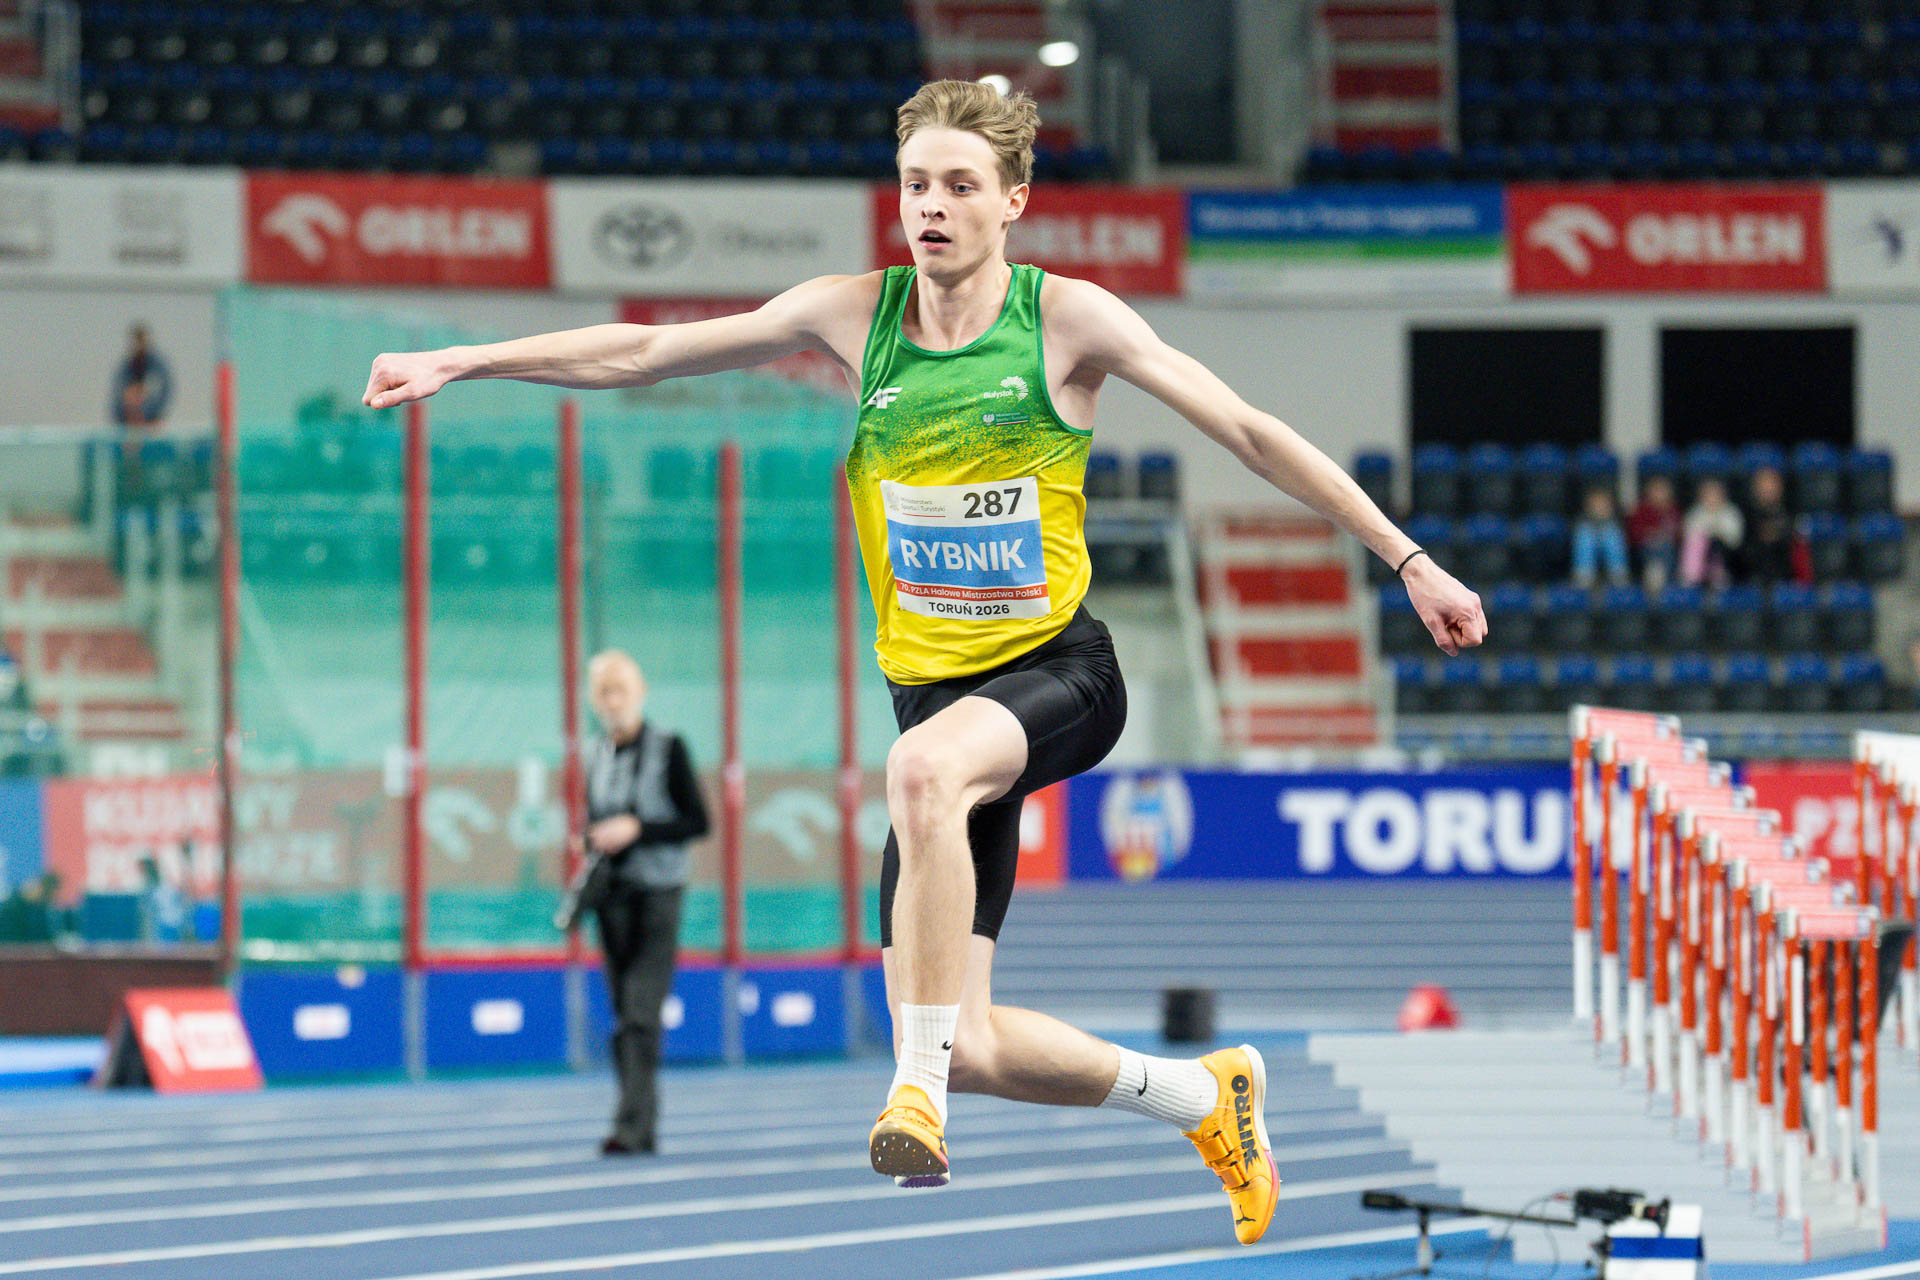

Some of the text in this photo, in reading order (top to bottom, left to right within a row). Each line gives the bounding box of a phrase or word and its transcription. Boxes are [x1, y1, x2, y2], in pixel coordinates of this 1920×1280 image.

[359, 205, 532, 259] ORLEN
[1626, 212, 1805, 265] ORLEN
[963, 487, 1022, 518] 287
[900, 538, 1026, 572] RYBNIK
[911, 586, 930, 595] PZLA
[930, 588, 961, 597] Halowe
[962, 590, 1014, 599] Mistrzostwa
[1015, 587, 1042, 598] Polski
[928, 602, 1010, 616] TORUŃ 2026
[1231, 1074, 1261, 1174] NITRO
